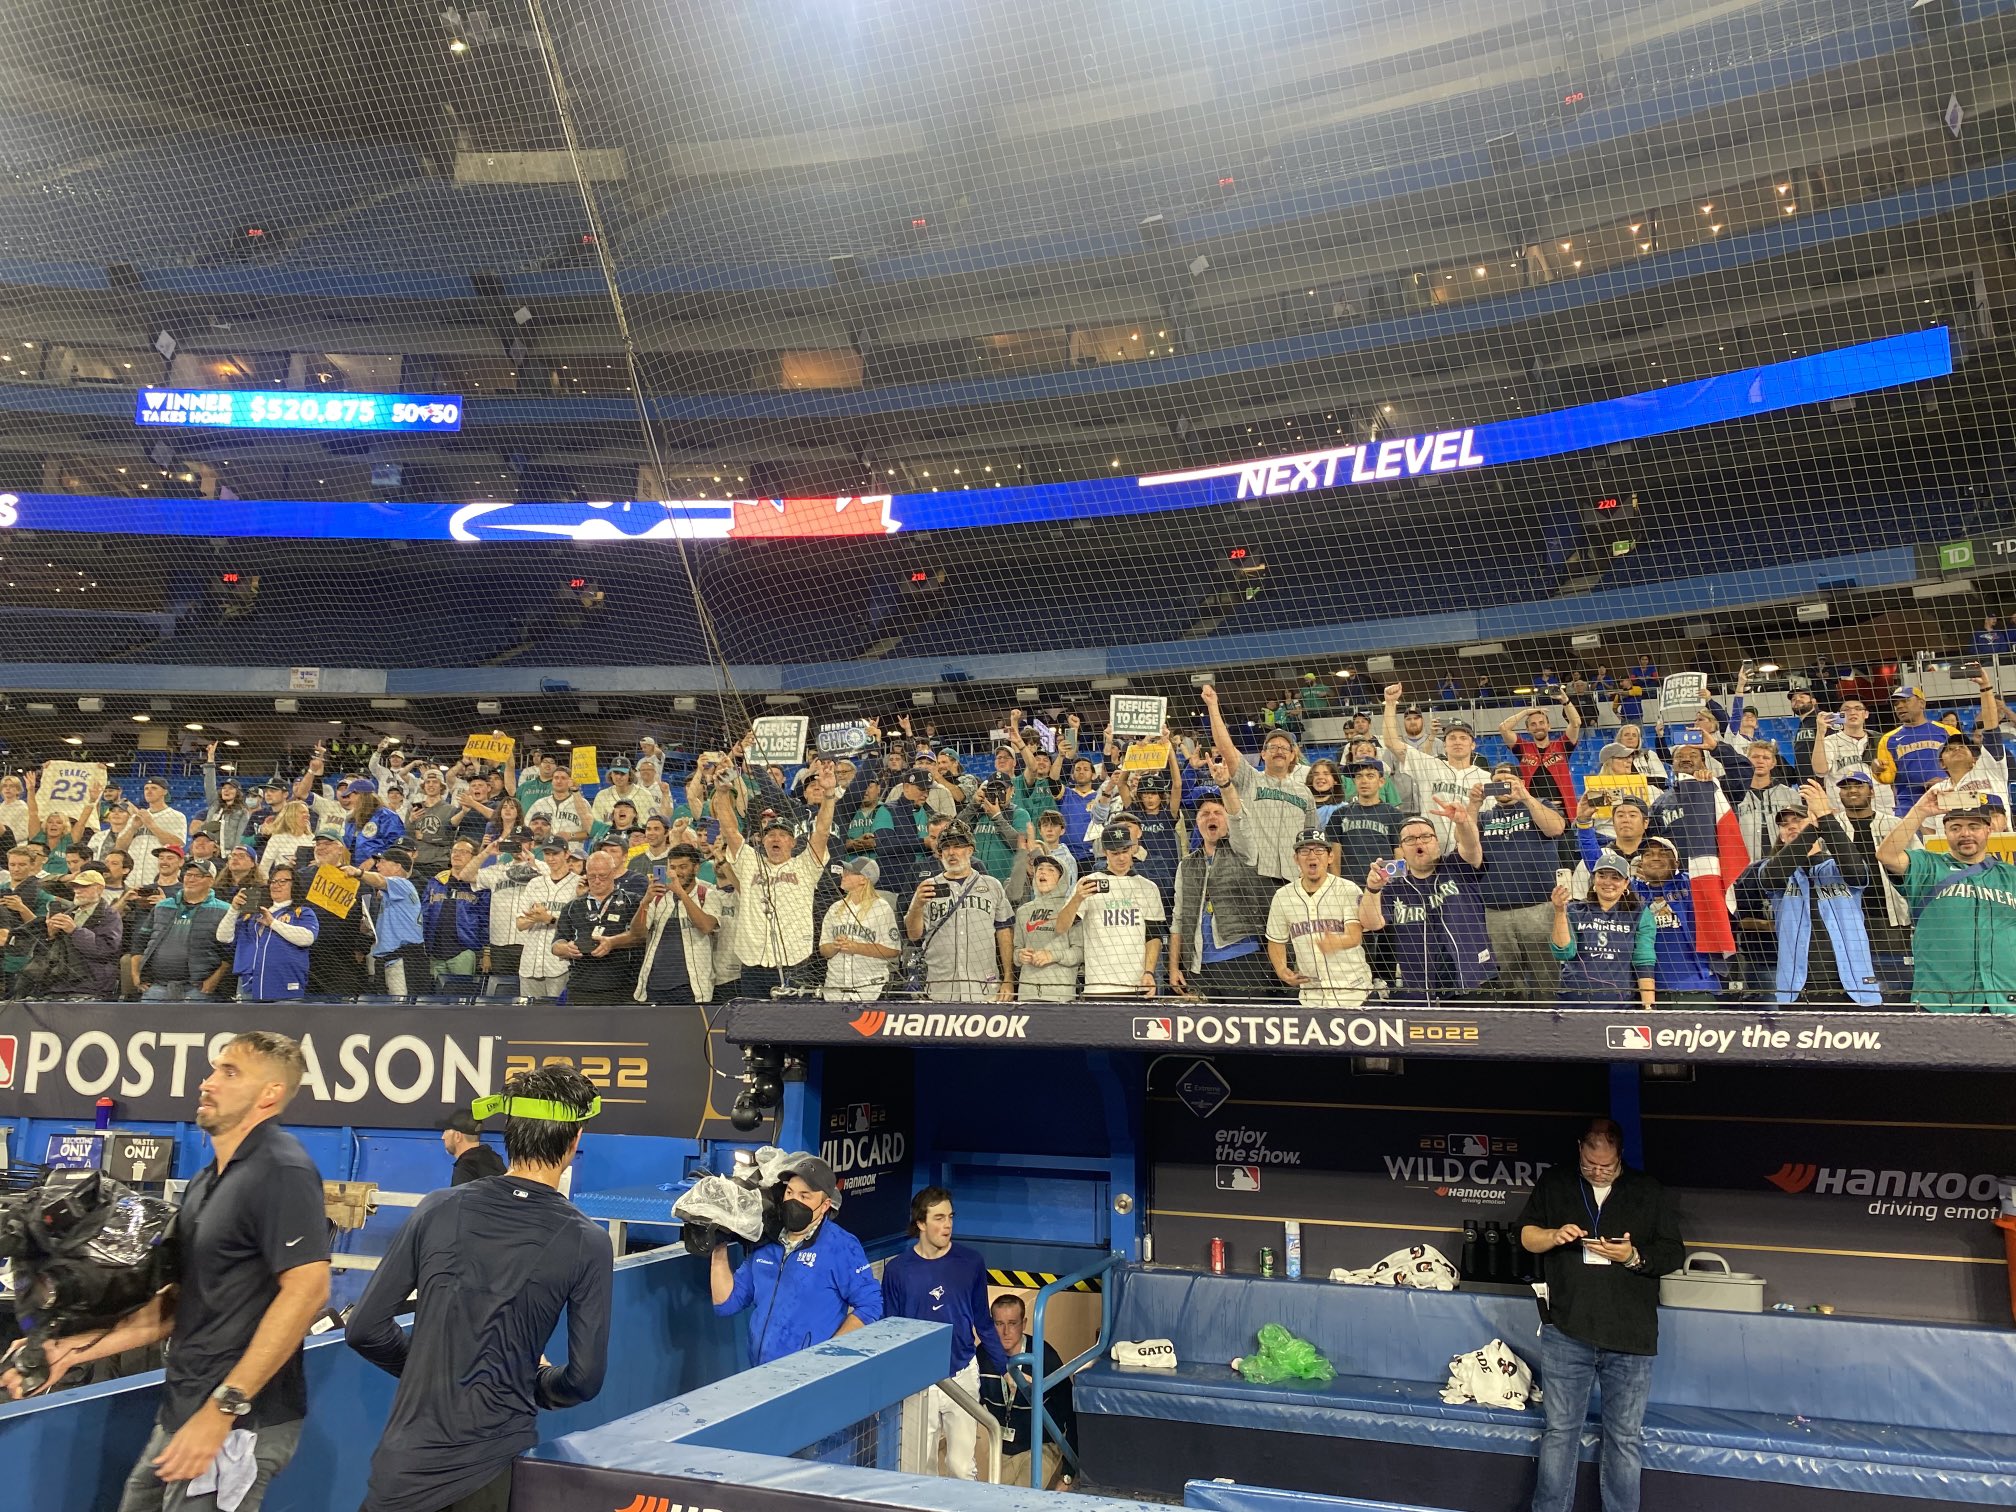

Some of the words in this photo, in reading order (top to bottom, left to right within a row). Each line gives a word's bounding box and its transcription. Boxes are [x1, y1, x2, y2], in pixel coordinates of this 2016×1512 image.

[1564, 92, 1584, 106] 520
[145, 393, 232, 411] WINNER
[142, 410, 188, 424] TAKES
[250, 399, 375, 423] $520,875
[1237, 446, 1356, 499] NEXT
[1351, 429, 1484, 483] LEVEL
[1599, 500, 1617, 509] 220
[1231, 550, 1246, 559] 219
[1943, 547, 1972, 564] TD
[223, 574, 238, 582] 216
[571, 579, 585, 587] 217
[911, 573, 926, 581] 218
[1667, 676, 1698, 691] REFUSE
[1665, 689, 1675, 699] TO
[1676, 686, 1698, 699] LOSE
[1118, 700, 1159, 713] REFUSE
[820, 721, 852, 731] EMBRACE
[1116, 713, 1131, 724] TO
[1132, 713, 1159, 725] LOSE
[755, 722, 798, 737] REFUSE
[468, 739, 511, 755] BELIEVE
[755, 737, 770, 751] TO
[771, 737, 797, 751] LOSE
[616, 759, 622, 767] S
[1128, 752, 1161, 762] BELIEVE
[59, 769, 91, 780] FRANCE
[996, 771, 1002, 779] S
[1147, 778, 1154, 788] S
[51, 780, 87, 803] 23
[1491, 812, 1524, 824] SEATTLE
[516, 826, 522, 834] S
[1341, 817, 1389, 836] MARINERS
[1484, 823, 1530, 837] MARINERS
[548, 835, 554, 844] S
[1313, 830, 1326, 842] 24
[312, 874, 355, 909] BELIEVE
[1935, 883, 2016, 910] MARINER
[929, 895, 992, 922] SEATTLE
[1030, 908, 1054, 922] NIKE
[1103, 909, 1141, 927] RISE
[1577, 922, 1631, 934] MARINERS
[1597, 931, 1608, 948] S
[1177, 1015, 1405, 1048] POSTSEASON
[1409, 1026, 1480, 1041] 2022
[1656, 1026, 1735, 1054] enjoy
[1742, 1025, 1791, 1050] the
[1797, 1025, 1882, 1051] show.
[24, 1031, 494, 1102] POSTASON
[505, 1056, 648, 1088] 222
[830, 1115, 844, 1127] 20
[871, 1110, 885, 1122] 22
[62, 1137, 94, 1145] RECYCLING
[1216, 1126, 1268, 1148] enjoy
[60, 1144, 92, 1157] ONLY
[124, 1145, 160, 1159] ONLY
[857, 1132, 905, 1169] CARD
[1420, 1138, 1446, 1151] 20
[1492, 1140, 1519, 1152] 22
[1216, 1144, 1249, 1162] the
[1250, 1145, 1301, 1165] show.
[1384, 1155, 1466, 1183] WILD
[1461, 1197, 1480, 1205] driving
[1867, 1200, 1937, 1221] driving
[1943, 1202, 2002, 1220] emot
[1138, 1345, 1173, 1356] GATO
